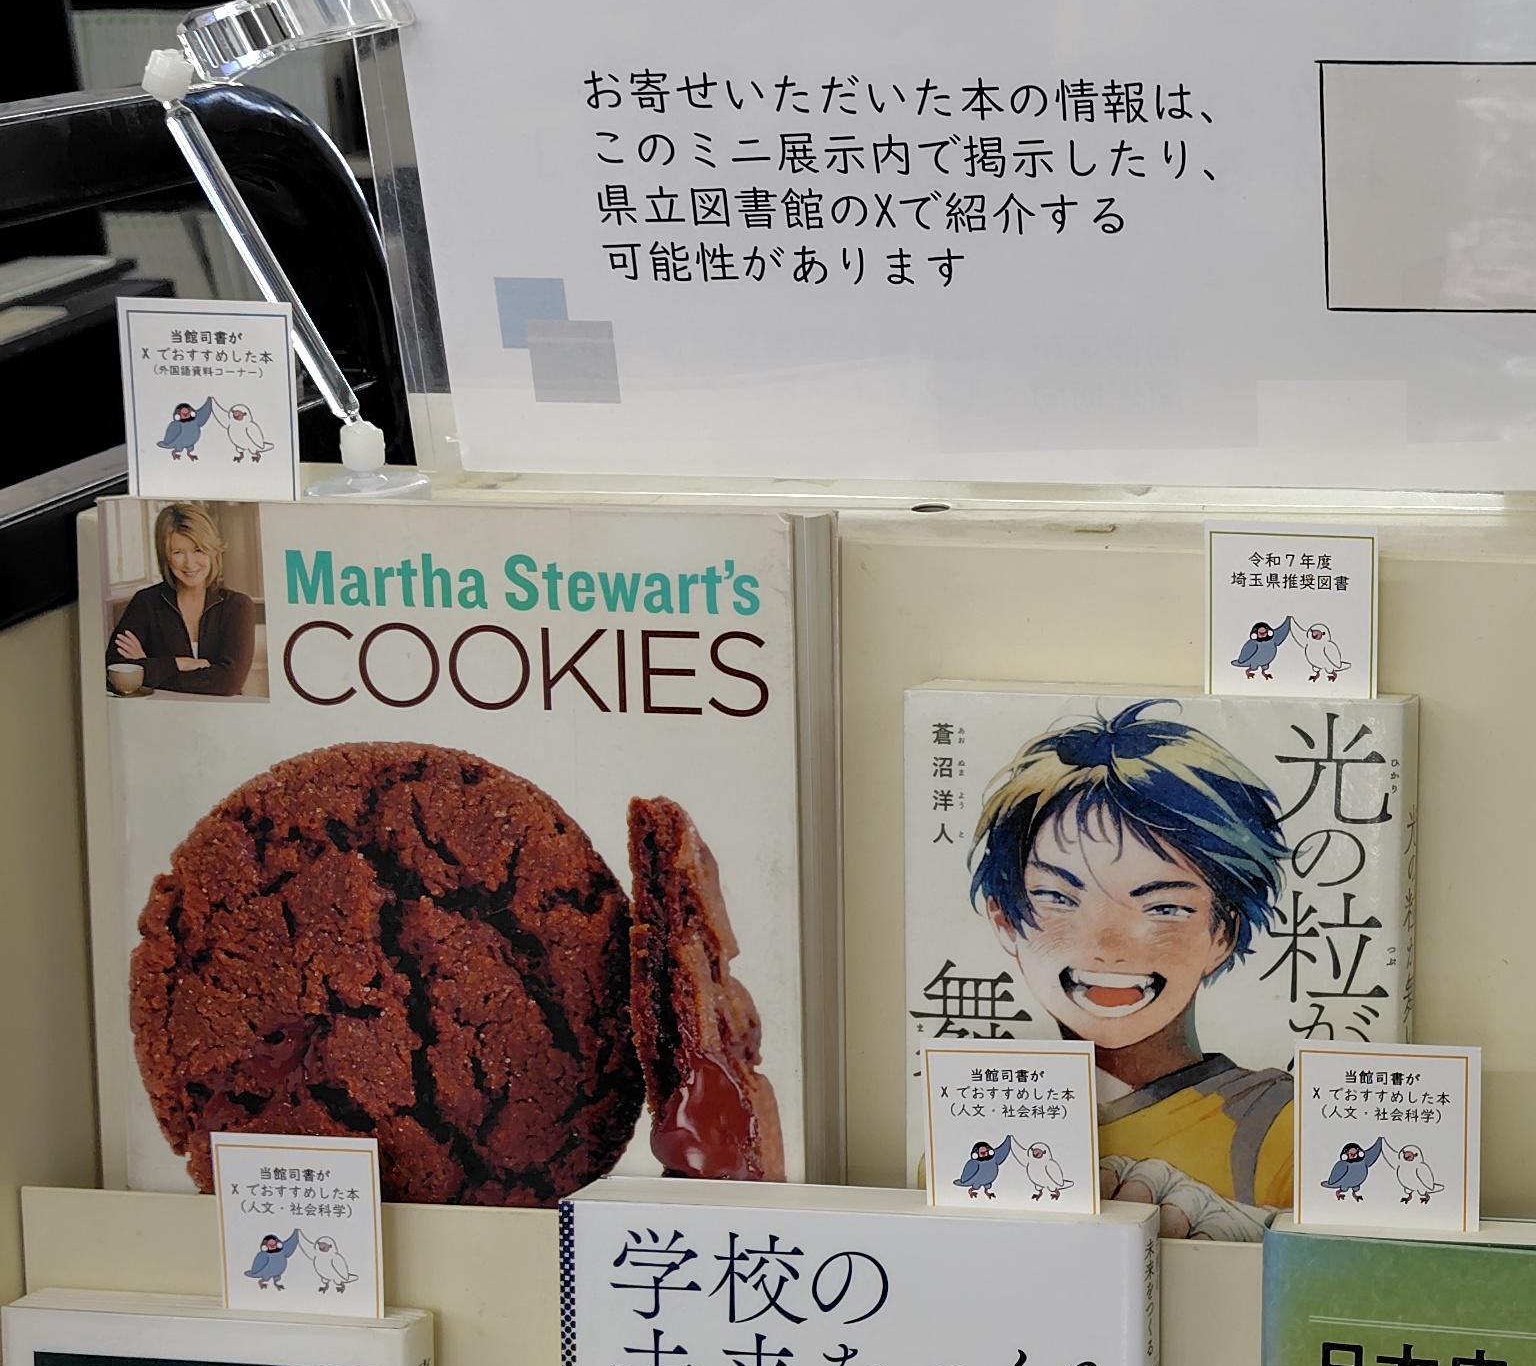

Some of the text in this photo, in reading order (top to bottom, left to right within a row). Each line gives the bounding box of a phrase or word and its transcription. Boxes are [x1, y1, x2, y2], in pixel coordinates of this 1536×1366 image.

[583, 68, 1214, 125] お寄せいただいた本の情報は、
[593, 131, 1216, 182] このミニ展示内で掲示したり、
[597, 183, 1126, 235] 県立図書館のXで紹介する
[602, 240, 967, 289] 可能性があります
[170, 329, 244, 346] 当館司書が
[142, 346, 274, 365] X でおすすめした本
[1248, 551, 1333, 571] 令和7年度
[284, 549, 761, 615] Martha Stewart's
[1231, 572, 1350, 592] 埼玉県推奨図書
[283, 620, 770, 717] COOKIES
[932, 723, 955, 846] 蒼沼洋人
[969, 1067, 1045, 1083] 当館司書が
[1344, 1069, 1421, 1086] 当館司書が
[940, 1086, 1076, 1102] X でおすすめした本
[1312, 1087, 1452, 1105] X でおすすめした本
[259, 1166, 330, 1182] 当館司書が
[231, 1185, 360, 1202] X でおすすめした本
[610, 1227, 889, 1325] 学校の
